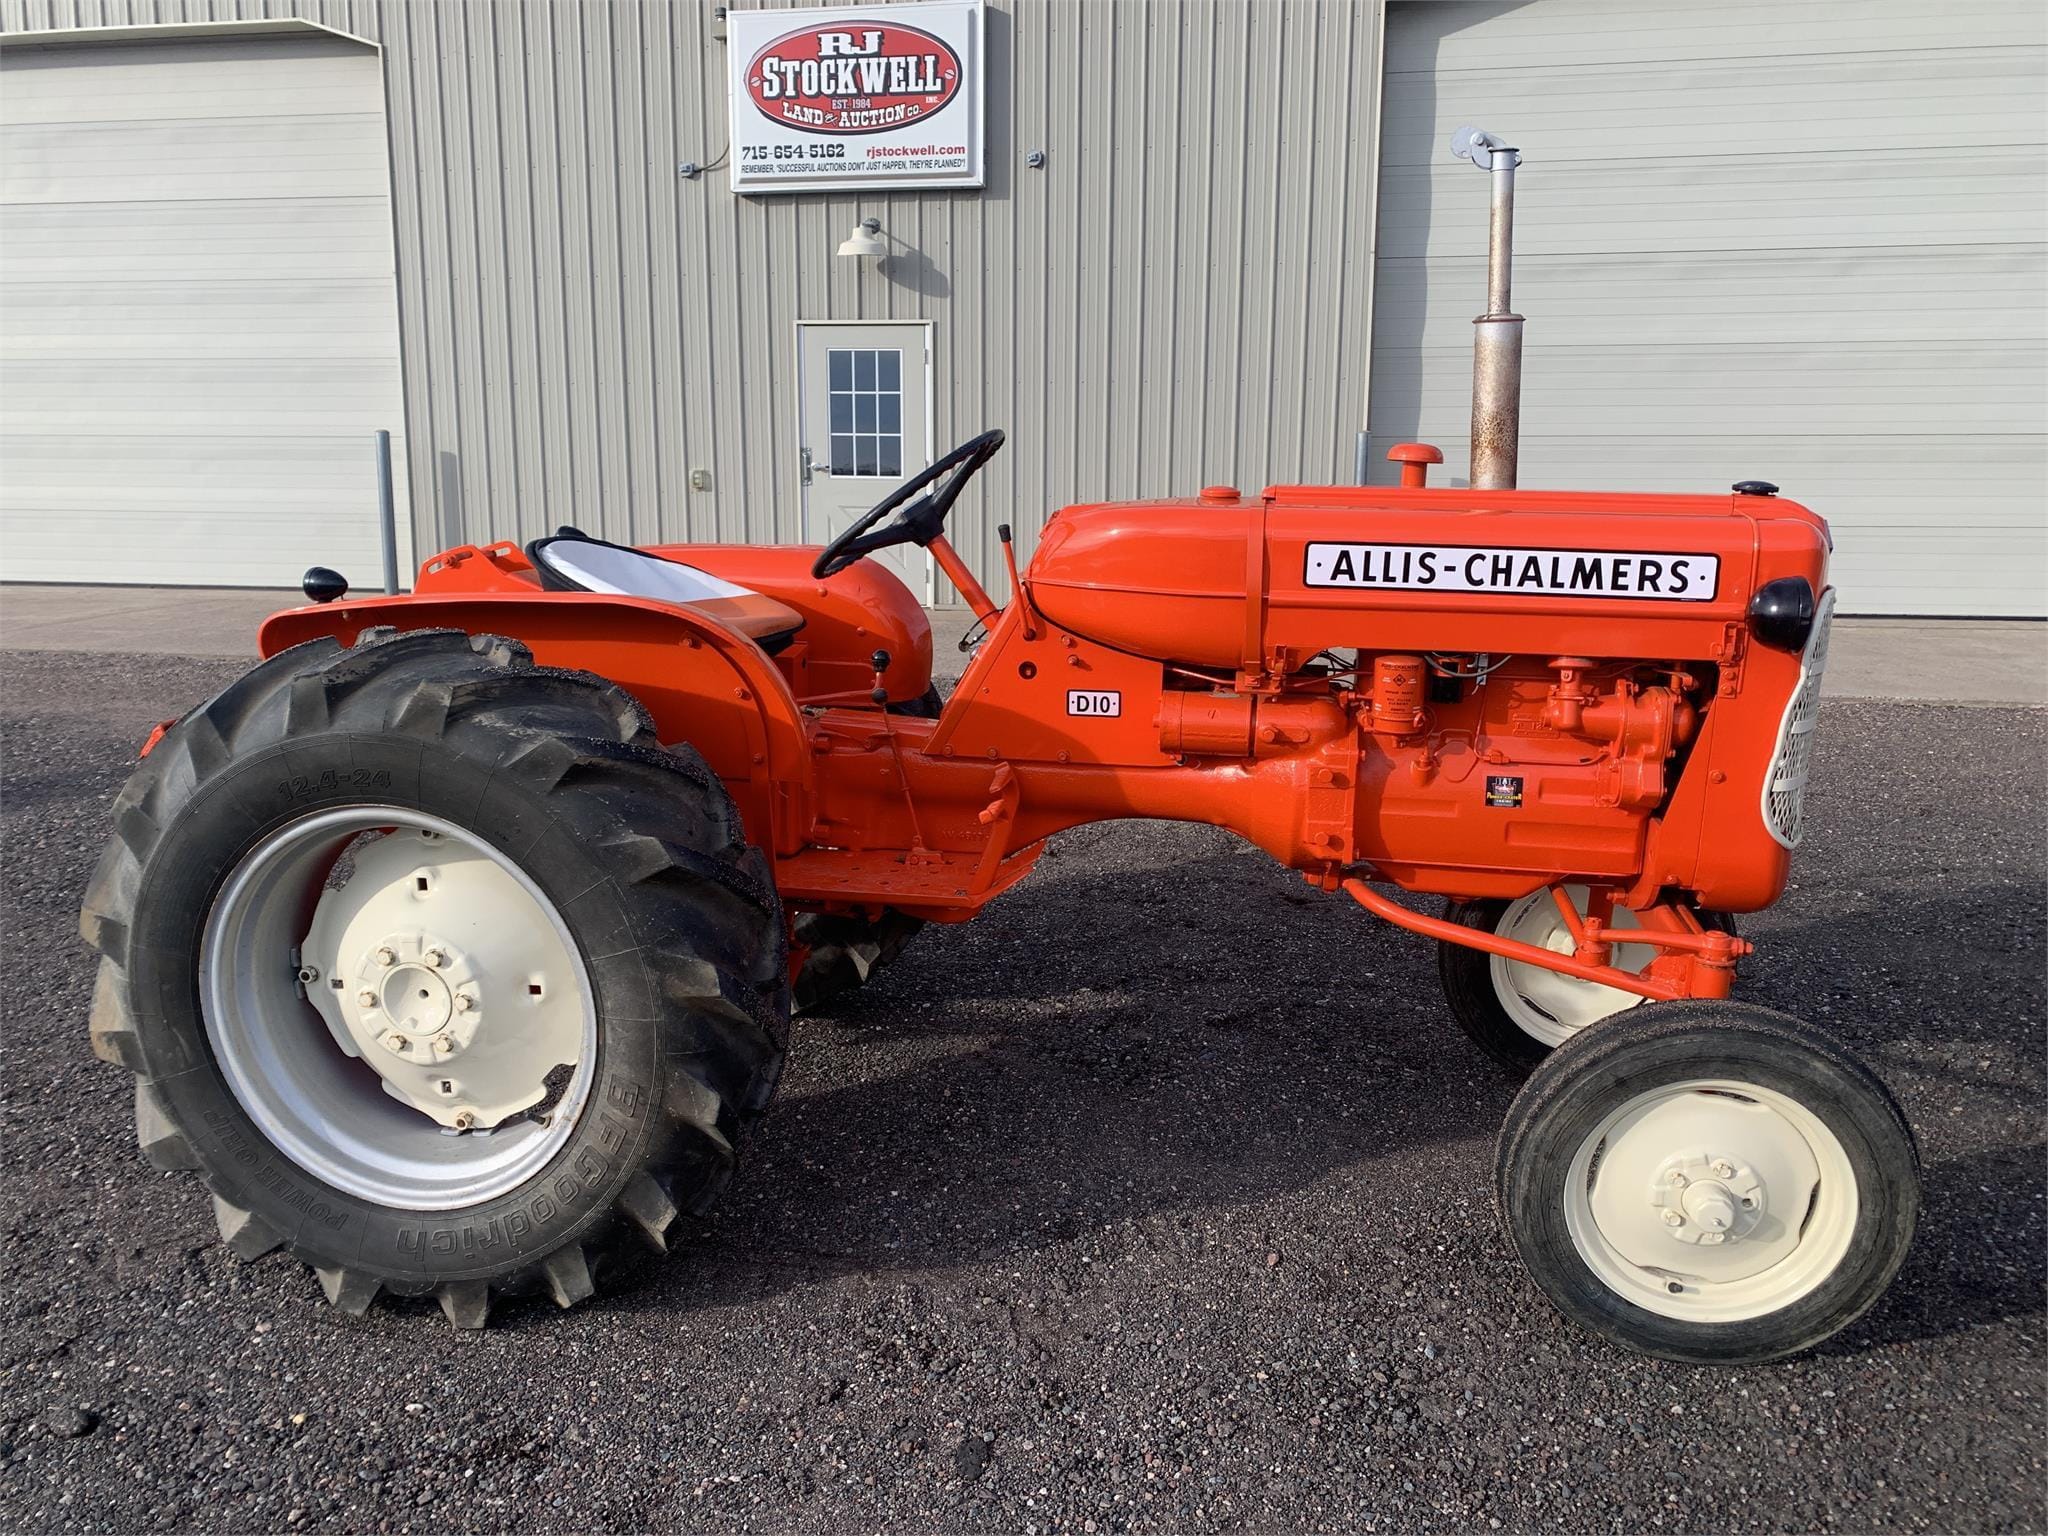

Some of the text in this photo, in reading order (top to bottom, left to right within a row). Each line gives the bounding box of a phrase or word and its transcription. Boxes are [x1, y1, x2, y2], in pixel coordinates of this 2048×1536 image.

[818, 31, 883, 56] RJ
[762, 55, 942, 98] STOCKWELL
[782, 102, 823, 125] LAND
[838, 104, 905, 128] AUCTION
[907, 104, 922, 117] CO.
[832, 98, 871, 110] EST. 1984
[742, 143, 845, 160] 715-654-5162
[866, 145, 966, 160] rjstockwell.com
[817, 162, 847, 172] AUCTIONS
[847, 161, 866, 171] DON'T
[866, 161, 881, 171] JUST
[882, 160, 908, 171] HAPPEN,
[909, 159, 933, 169] THEY'RE
[1329, 549, 1690, 594] ALLIS-CHALMERS
[279, 768, 391, 801] 12.4-24
[203, 1110, 350, 1231] POWER GRIP
